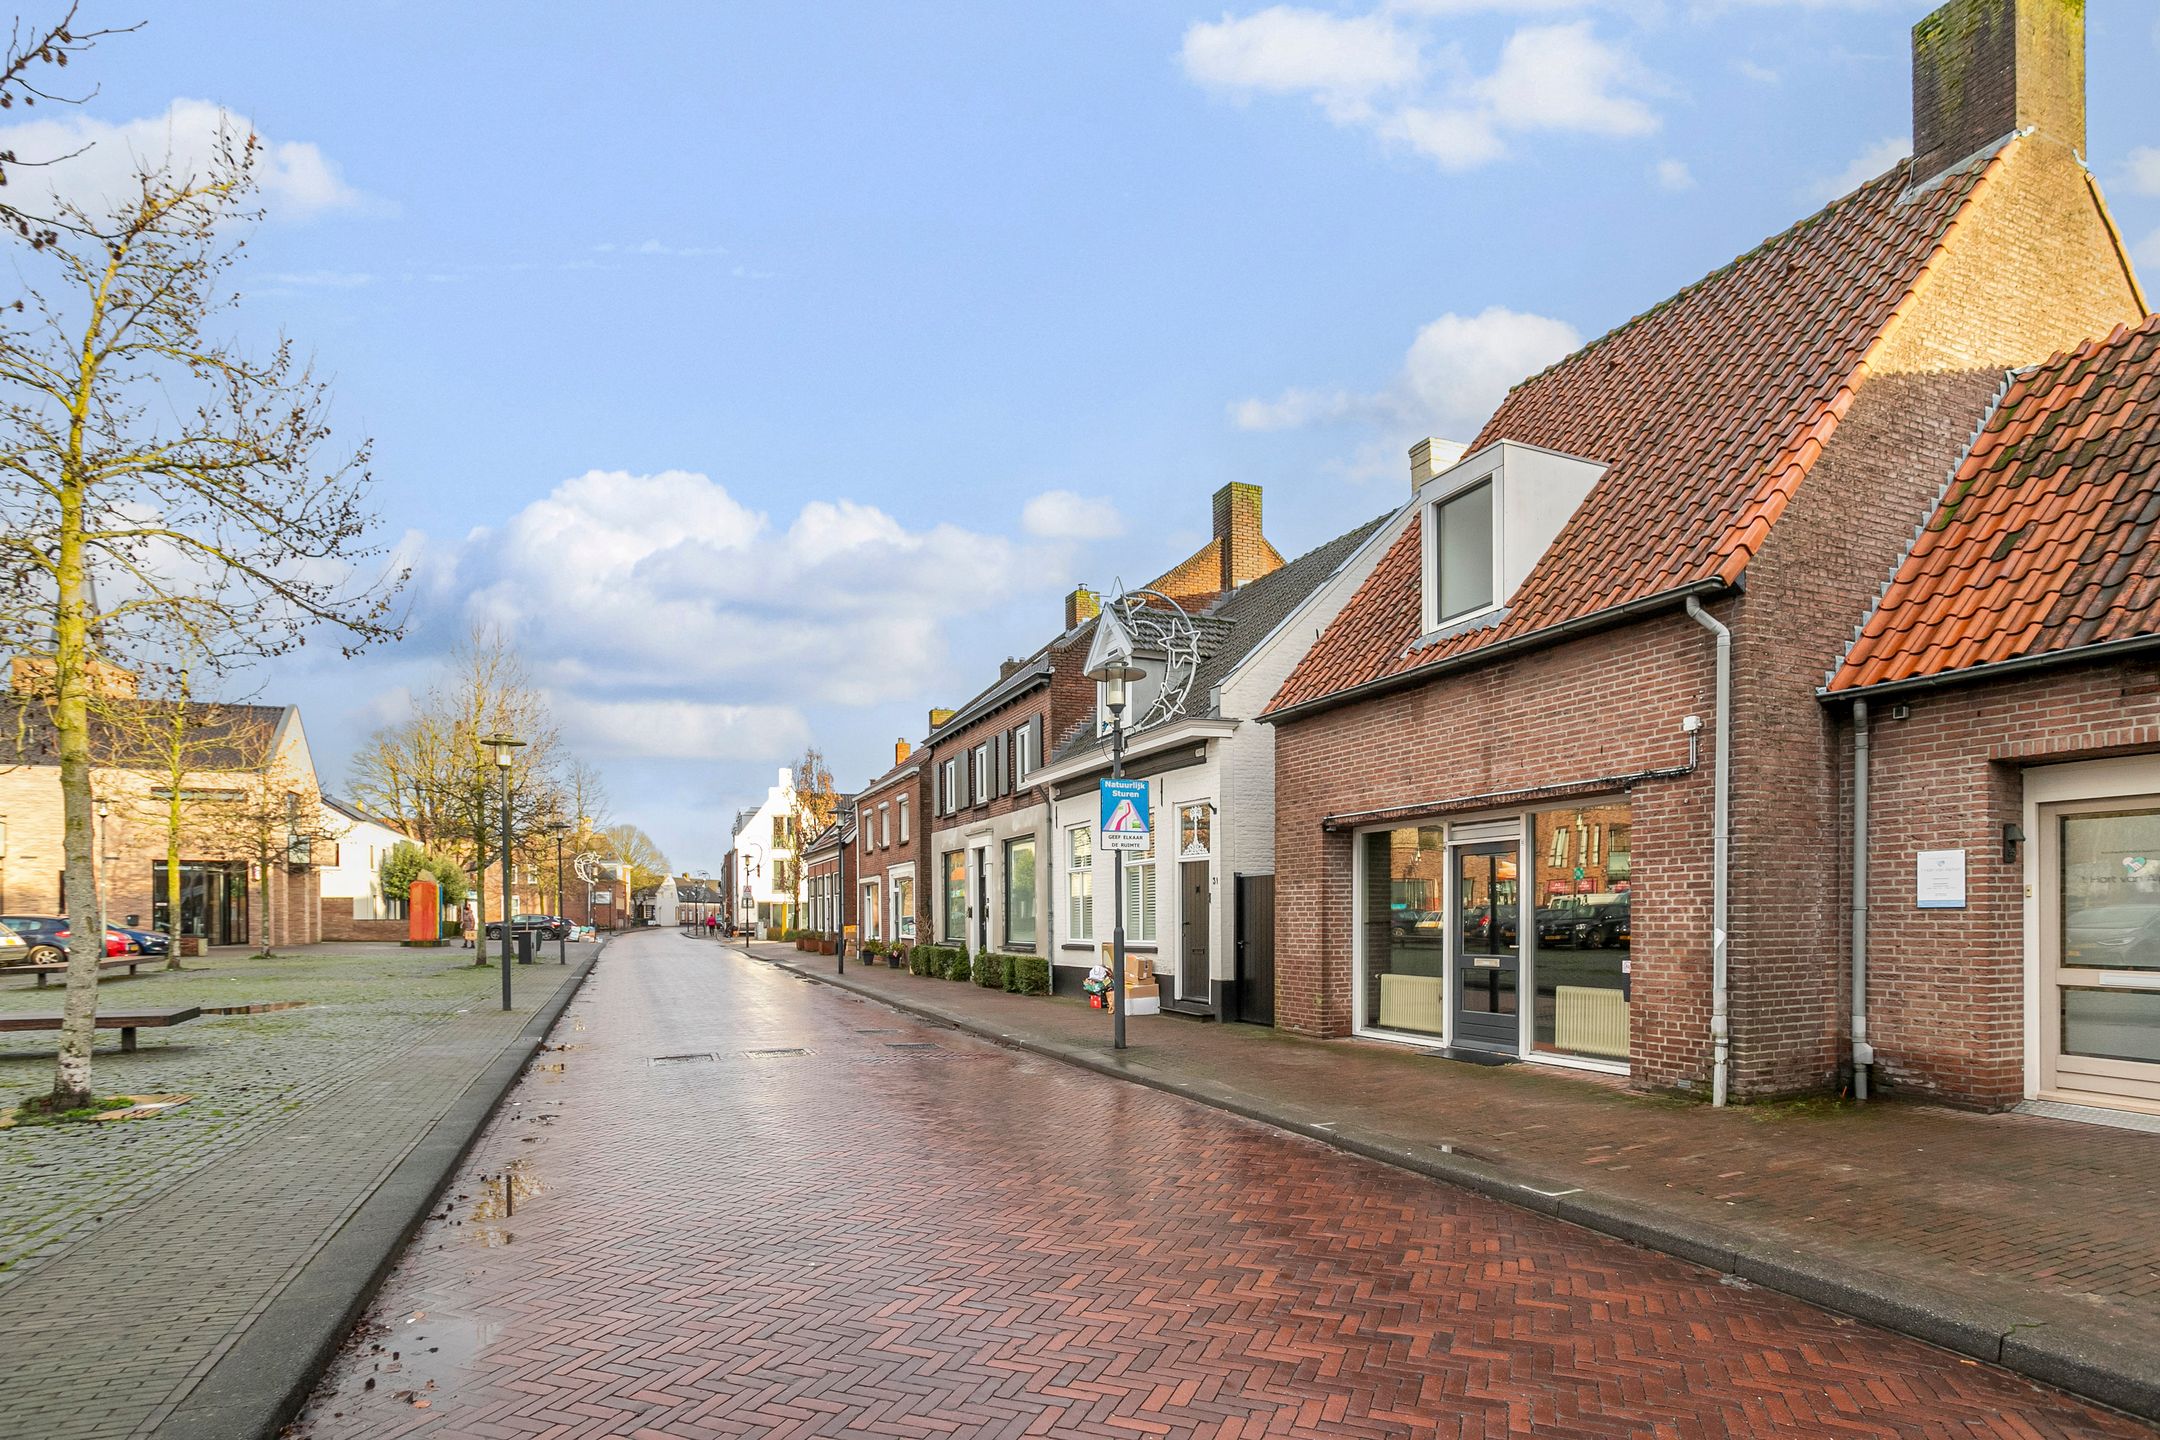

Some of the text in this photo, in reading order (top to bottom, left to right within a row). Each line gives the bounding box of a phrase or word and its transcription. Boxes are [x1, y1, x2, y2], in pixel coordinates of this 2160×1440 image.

[1104, 781, 1146, 790] Natuurlijk
[1112, 790, 1140, 798] Sturen
[1212, 876, 1219, 885] 31
